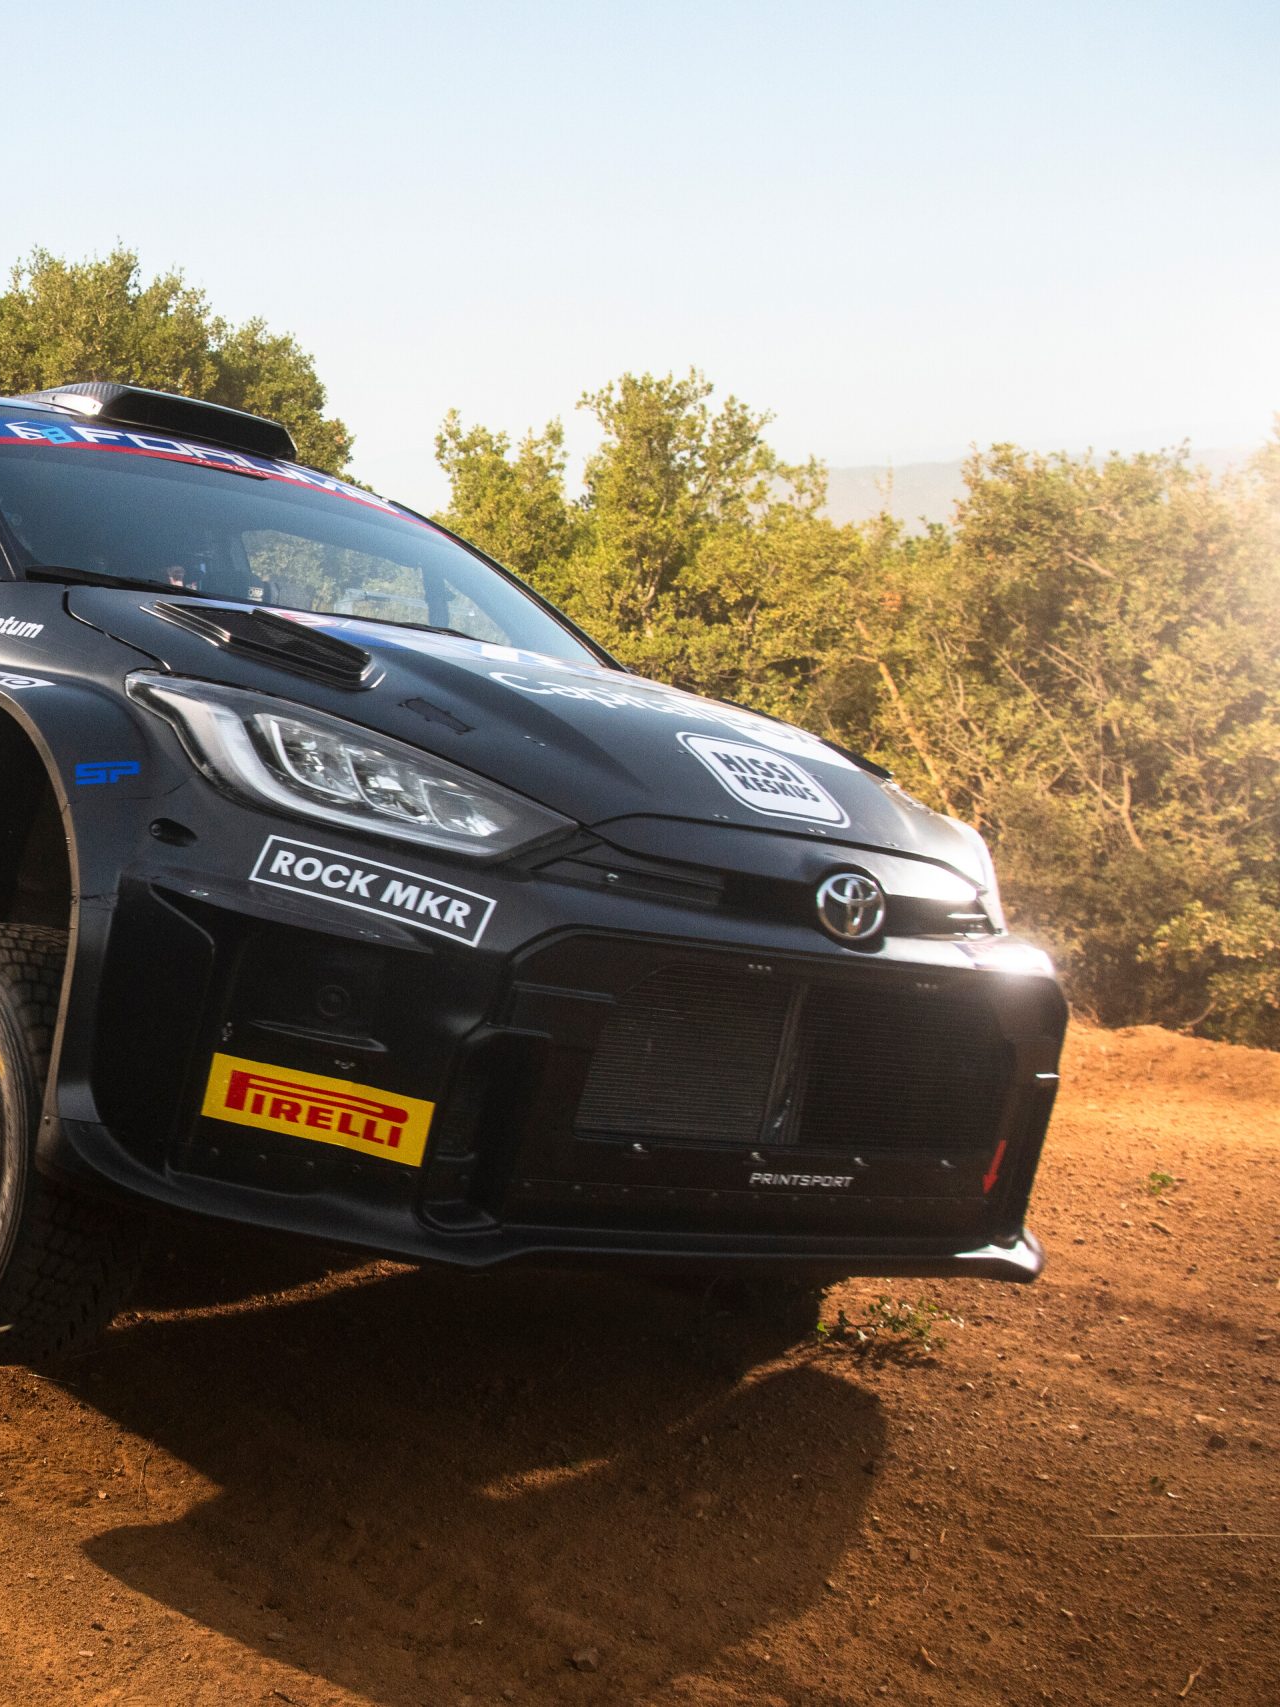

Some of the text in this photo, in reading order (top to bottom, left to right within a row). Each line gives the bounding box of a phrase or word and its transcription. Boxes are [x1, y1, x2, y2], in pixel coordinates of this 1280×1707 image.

[711, 751, 805, 785] HISSI
[733, 774, 821, 803] KESKUS
[269, 849, 472, 929] ROCK MKR
[224, 1069, 409, 1149] PIRELLI
[749, 1172, 855, 1188] PRINTSPORT
